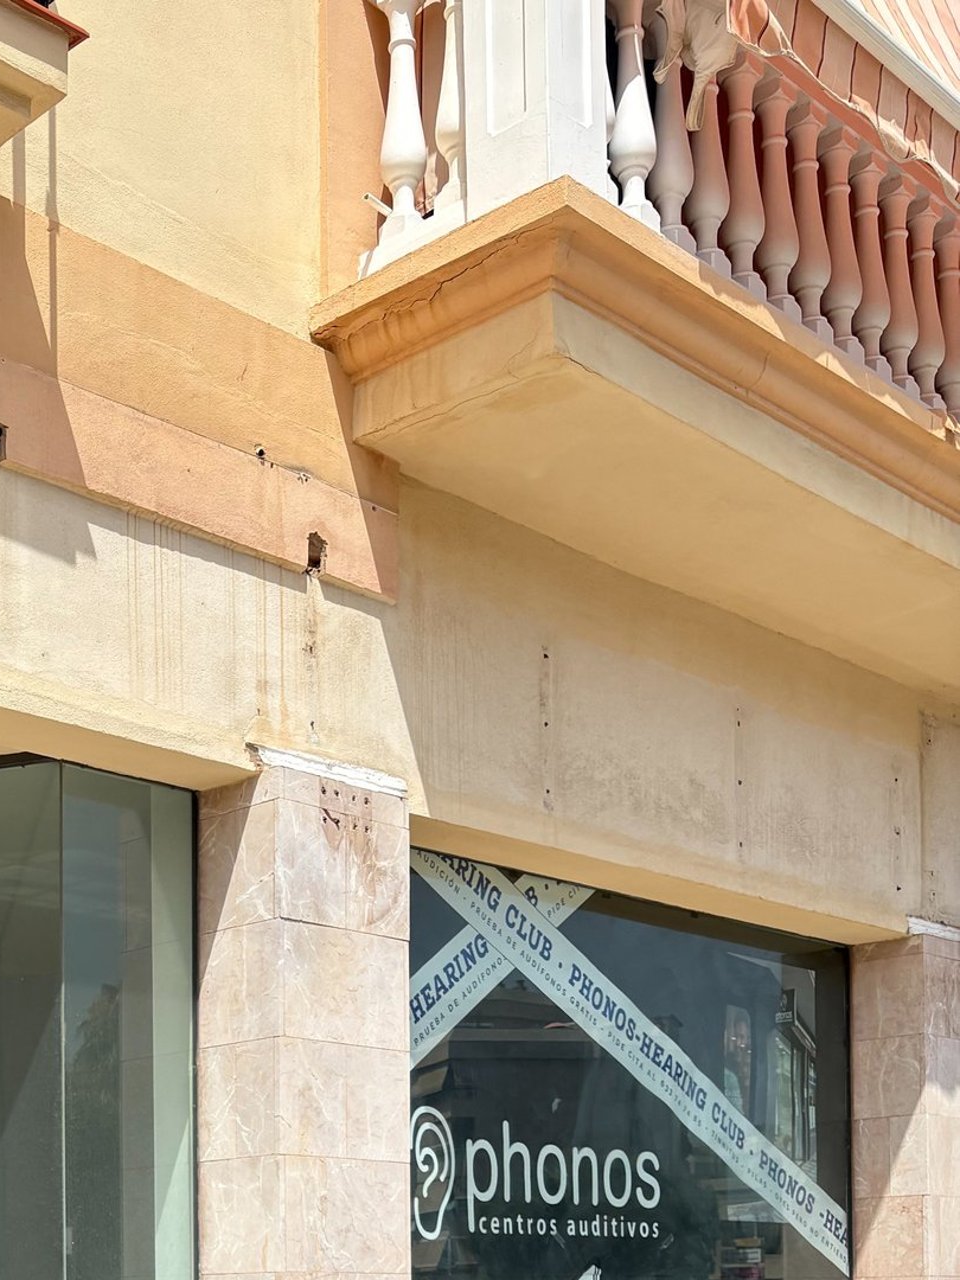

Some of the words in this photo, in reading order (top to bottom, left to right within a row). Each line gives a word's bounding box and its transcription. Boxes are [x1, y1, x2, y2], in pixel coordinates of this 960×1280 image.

[413, 1012, 445, 1046] PRUEBA
[447, 998, 460, 1013] DE
[470, 901, 503, 937] PRUEBA
[505, 936, 518, 951] DE
[520, 950, 567, 997] AUDÍFONOS
[569, 996, 597, 1027] GRATIS
[607, 1031, 626, 1052] PIDE
[627, 1050, 644, 1070] CITA
[504, 903, 553, 962] CLUB
[711, 1102, 746, 1150] CLUB
[758, 1150, 816, 1215] PHONOS
[465, 1119, 661, 1234] phonos
[478, 1214, 558, 1236] centros
[566, 1213, 660, 1239] auditivos
